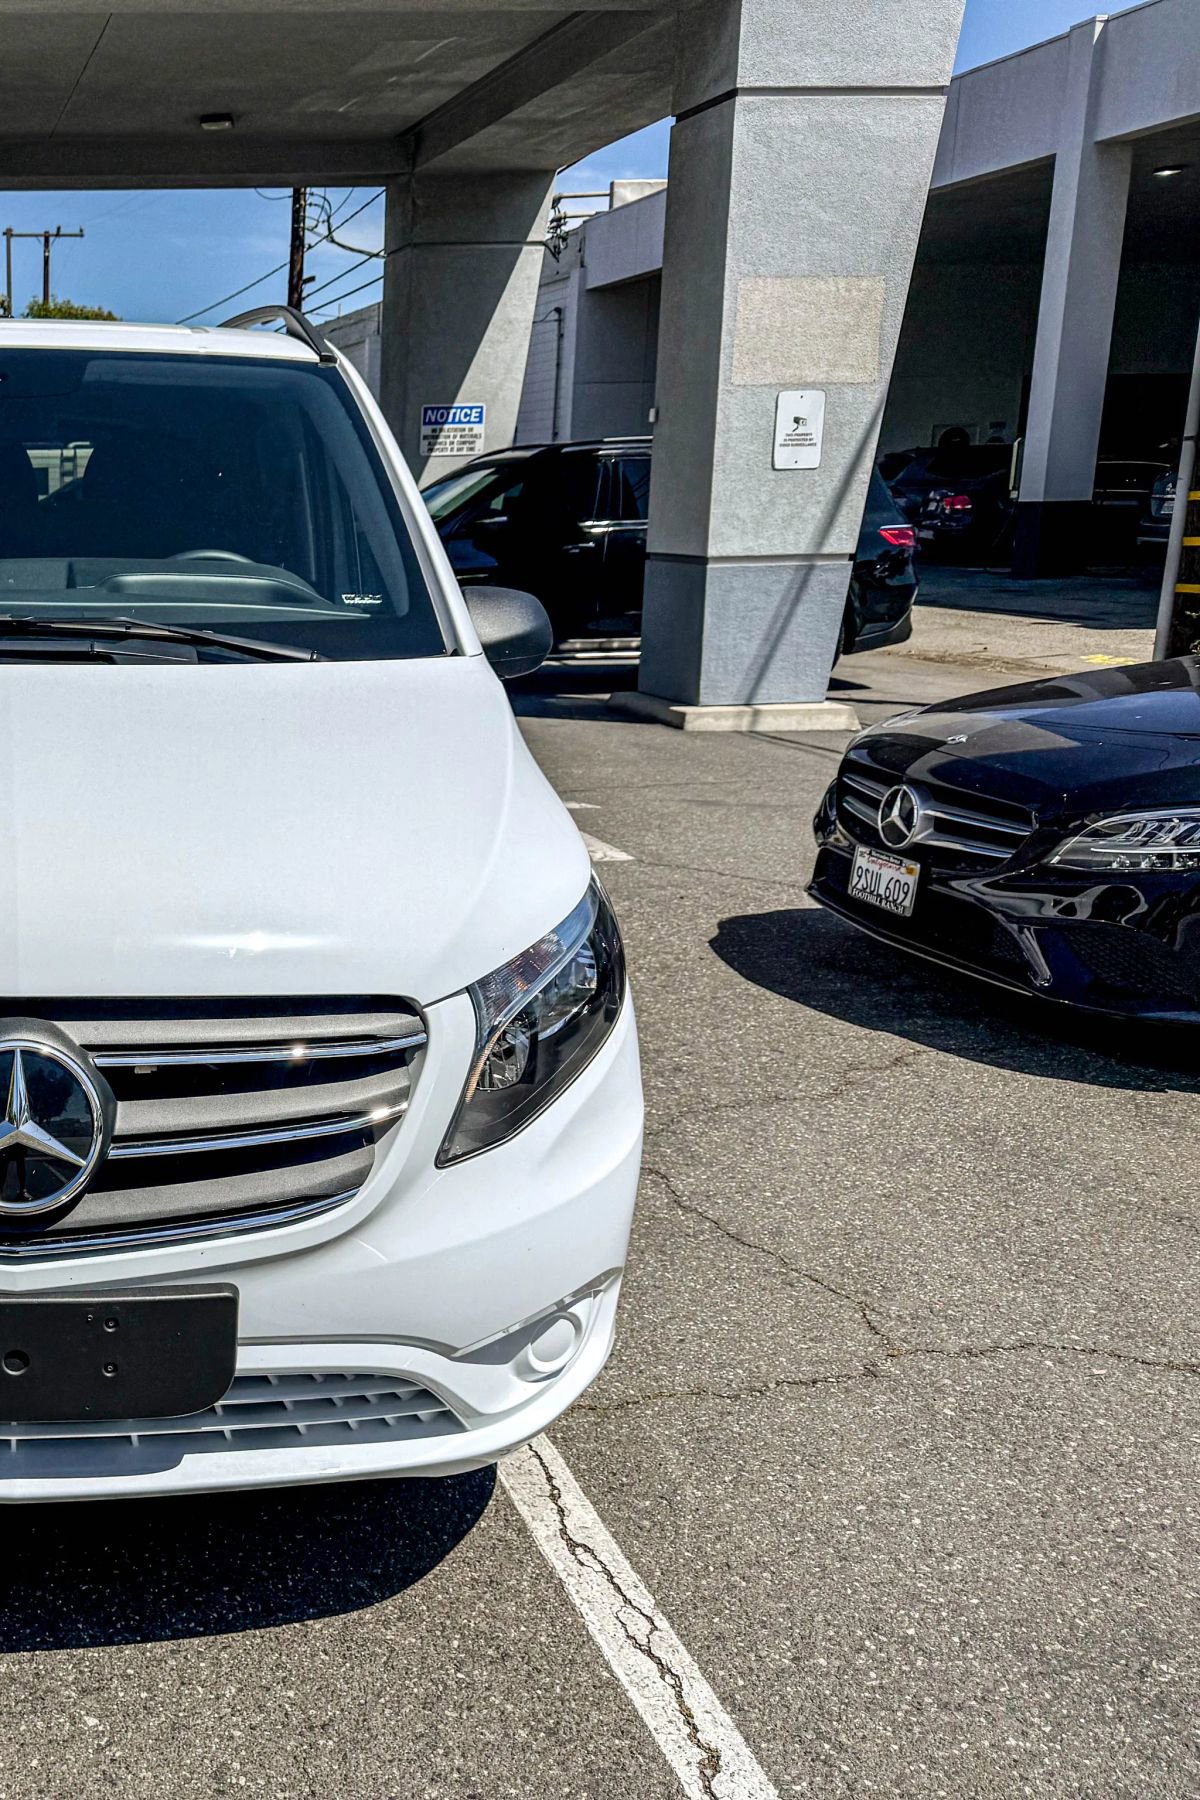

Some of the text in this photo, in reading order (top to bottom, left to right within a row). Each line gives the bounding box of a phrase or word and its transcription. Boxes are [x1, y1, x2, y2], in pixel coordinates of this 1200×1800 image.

[425, 408, 481, 423] NOTICE
[852, 865, 911, 905] 9SUL609
[852, 888, 904, 915] FOOTHILL RANCH
